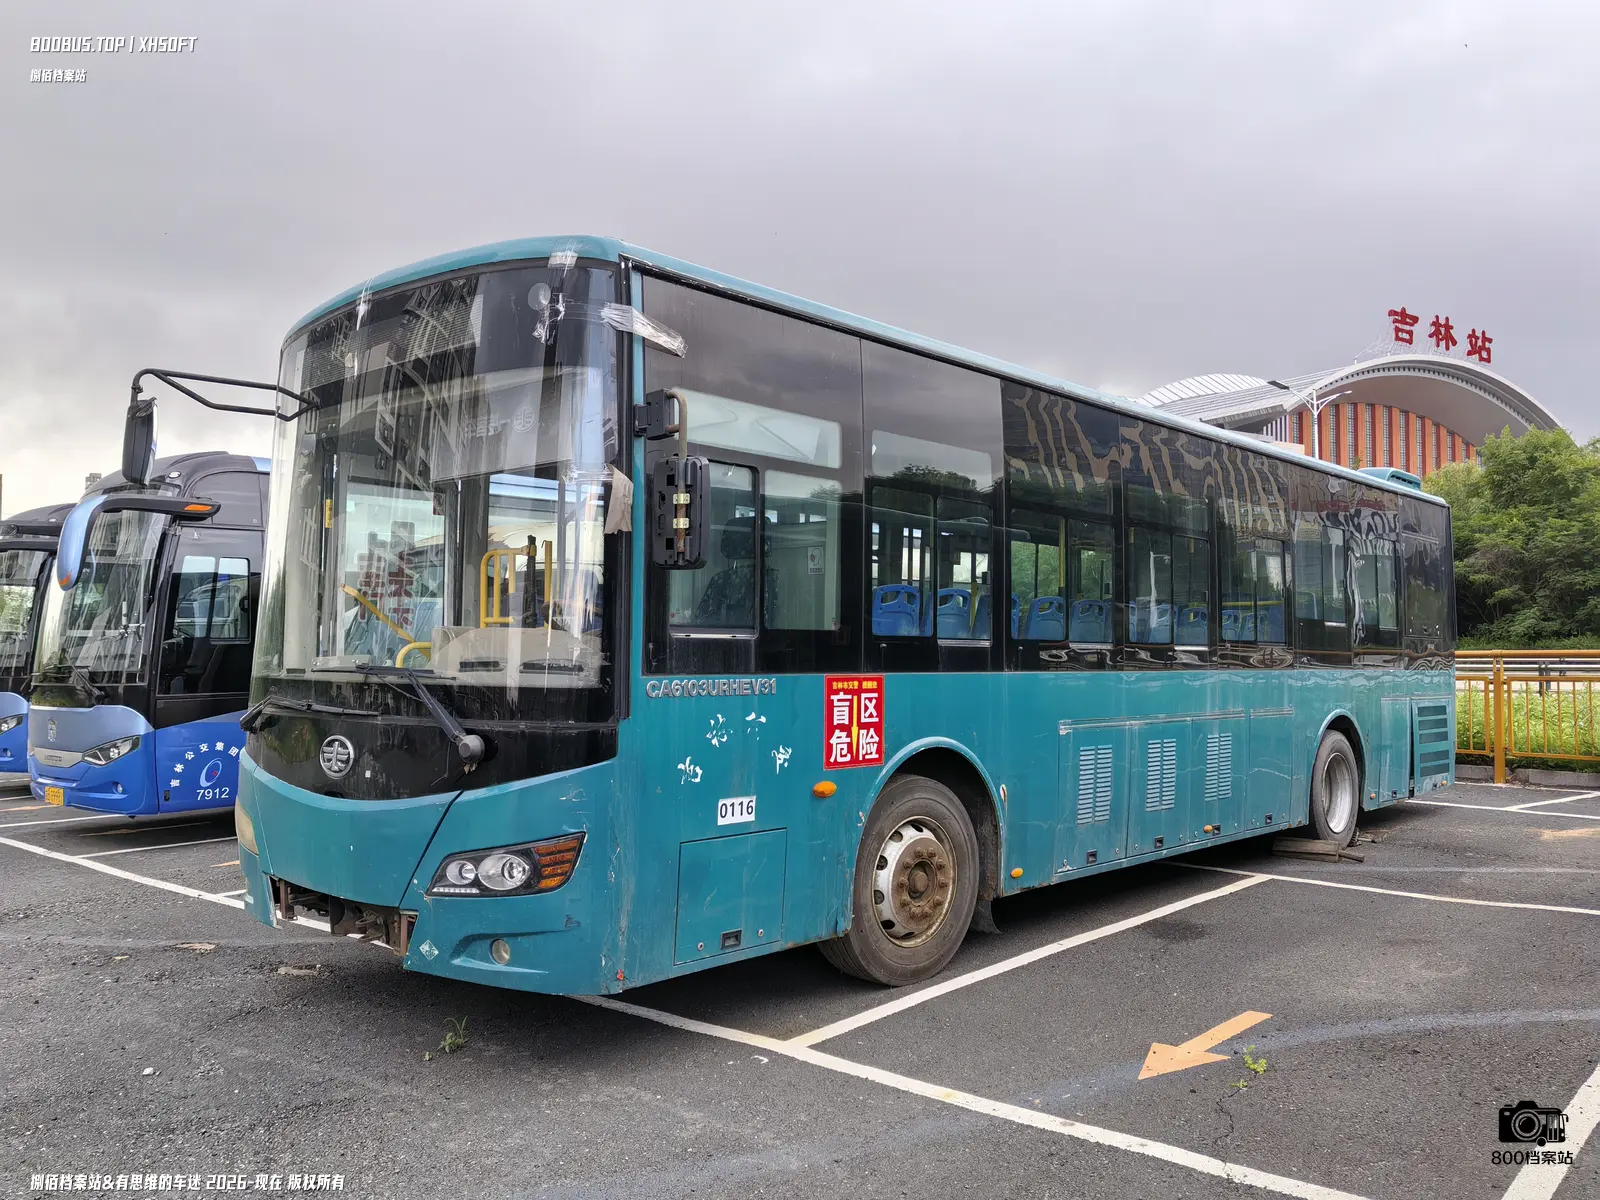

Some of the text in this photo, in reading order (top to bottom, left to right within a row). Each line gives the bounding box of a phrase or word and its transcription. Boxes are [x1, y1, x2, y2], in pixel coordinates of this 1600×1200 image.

[1387, 306, 1493, 364] 吉林站
[646, 678, 777, 698] CA6103URHEV31
[830, 691, 879, 726] 盲区
[829, 727, 880, 763] 危险
[196, 787, 230, 801] 7912
[719, 800, 754, 818] 0116
